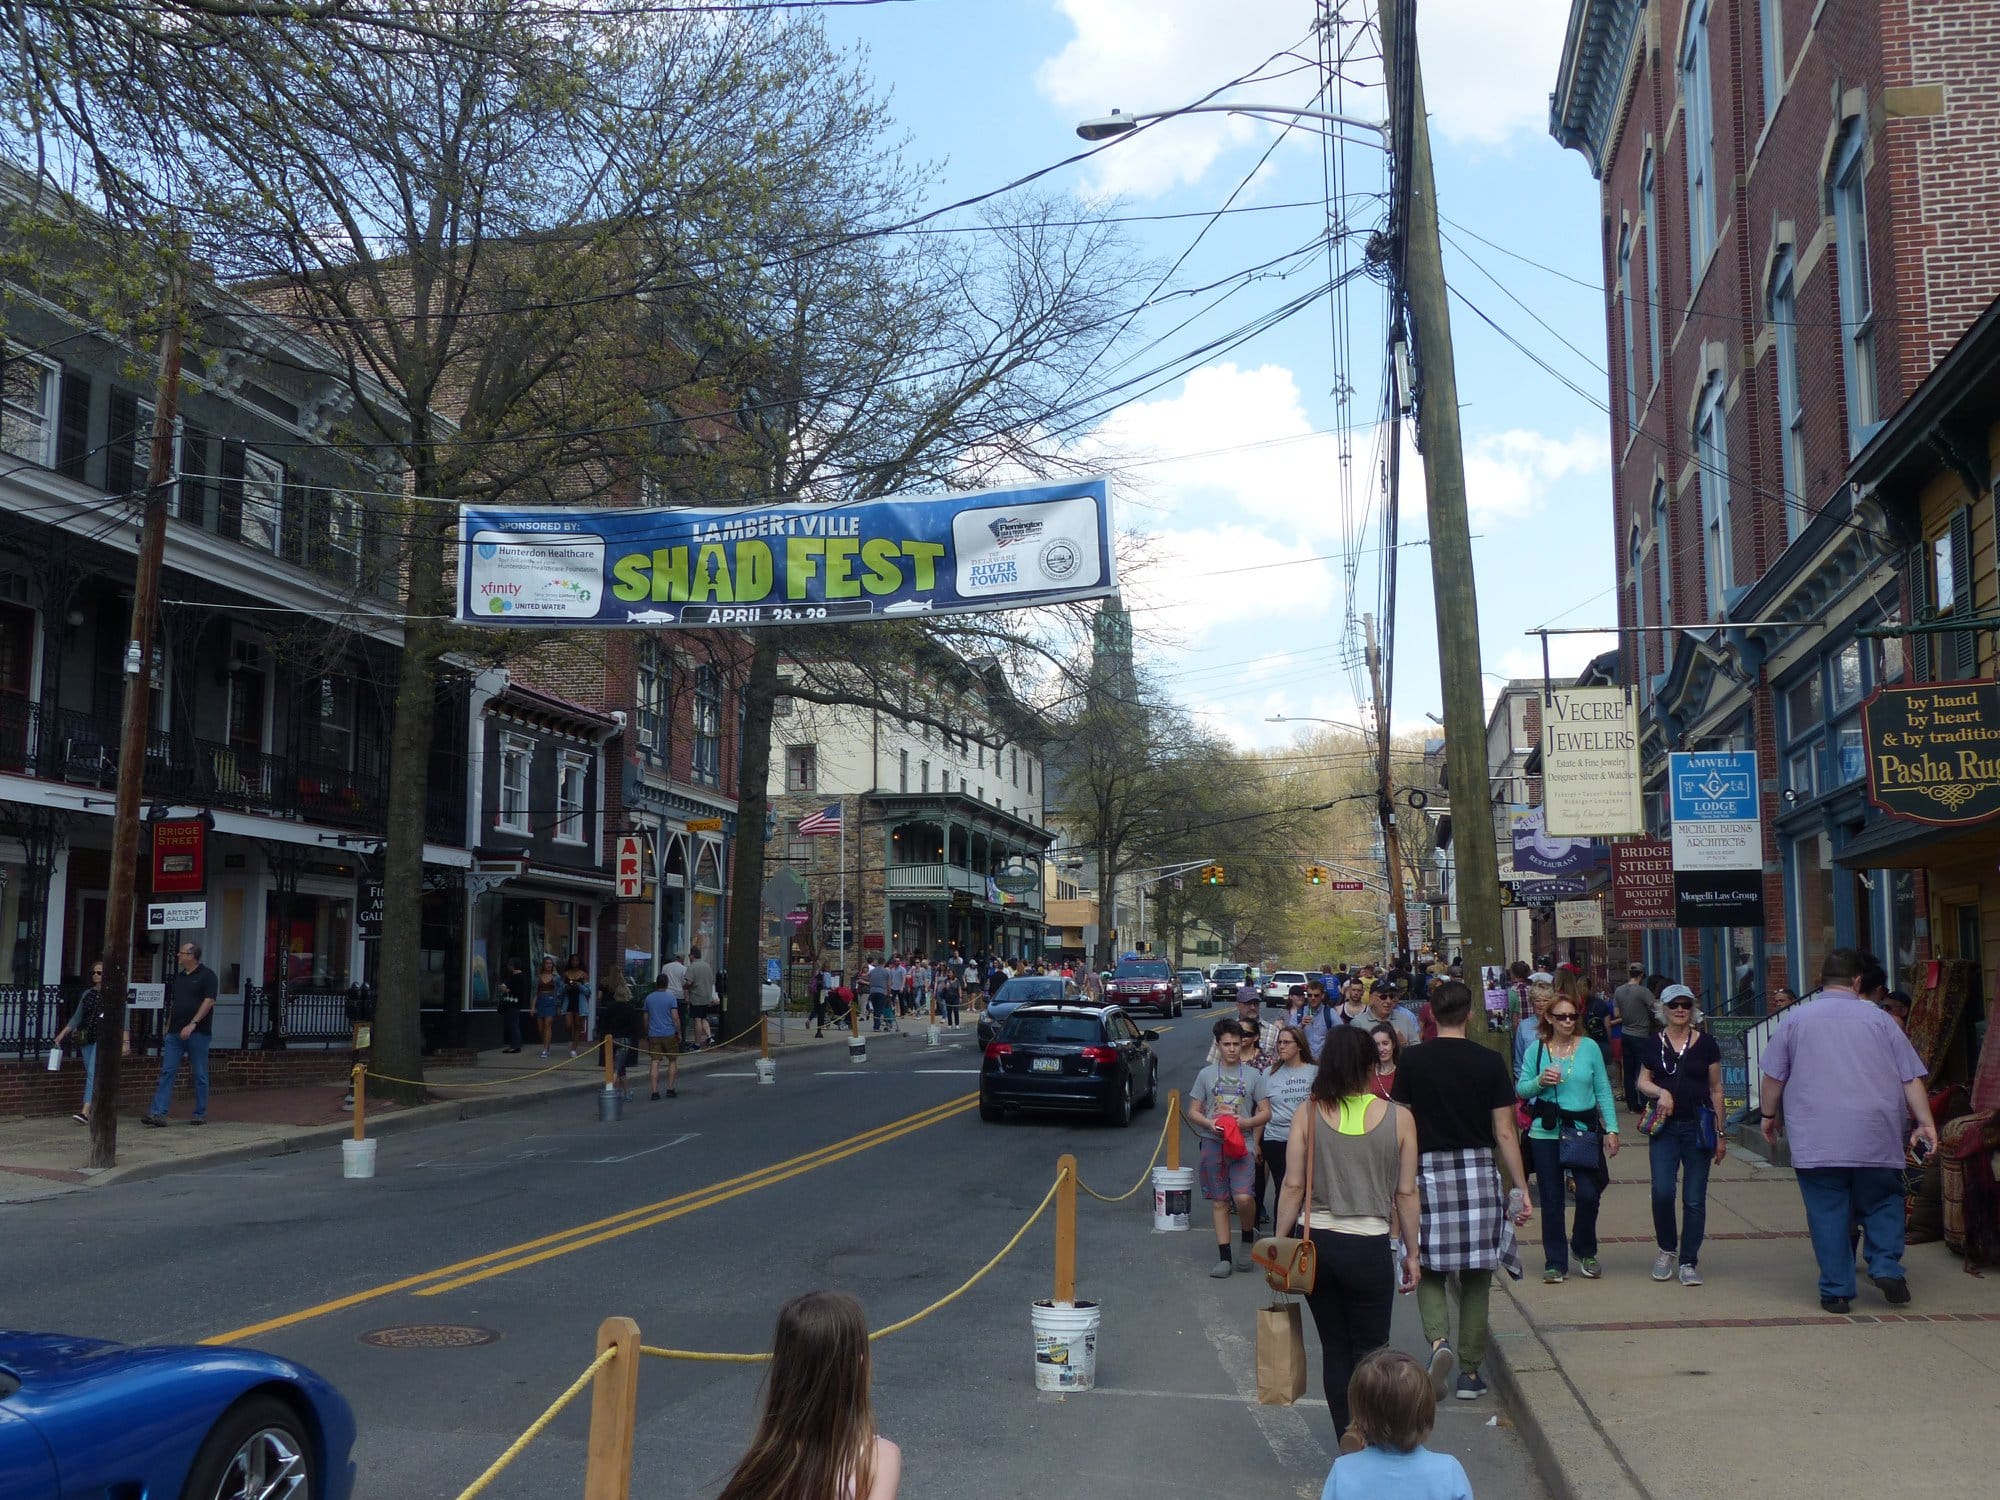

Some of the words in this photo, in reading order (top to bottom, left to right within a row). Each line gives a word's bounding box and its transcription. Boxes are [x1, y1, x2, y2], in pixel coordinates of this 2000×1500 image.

[499, 522, 561, 531] SPONSORED
[563, 522, 581, 531] BY:
[692, 514, 860, 543] LAMBERTVILLE
[999, 520, 1043, 531] Flemington
[499, 547, 546, 557] Hunterdon
[548, 548, 595, 558] Healthcare
[612, 539, 774, 602] SHAD
[786, 537, 945, 600] FEST
[971, 561, 1016, 576] RIVER
[969, 571, 1018, 586] TOWNS
[480, 581, 522, 596] xfinity
[1905, 696, 1929, 712] by
[1932, 692, 1979, 708] hand
[1905, 713, 1929, 729] by
[1932, 709, 1983, 725] heart
[1882, 732, 1900, 747] &
[1901, 731, 1925, 748] by
[1929, 727, 2000, 743] traditio
[1585, 758, 1599, 768] Fine
[1600, 758, 1626, 769] Jewelry
[1686, 757, 1741, 769] AMWELL
[1878, 752, 1954, 785] Pasha
[1708, 780, 1719, 792] G
[1694, 801, 1737, 811] LODGE
[158, 826, 200, 836] BRIDGE
[1678, 824, 1718, 834] MICHAEL
[1720, 823, 1753, 833] BURNS
[158, 836, 200, 846] STREET
[1686, 837, 1746, 848] ARCHITECTS
[1620, 846, 1671, 858] BRIDGE
[620, 838, 639, 896] ART
[1528, 854, 1579, 868] RESTAURANT
[1619, 860, 1673, 872] STREET
[1625, 889, 1670, 898] BOUGHT
[1680, 891, 1713, 903] Mongelli
[1714, 891, 1730, 900] Law
[1732, 890, 1758, 902] Group
[1633, 898, 1662, 907] SOLD
[151, 912, 162, 920] AG
[1621, 908, 1676, 917] APPRAISALS
[165, 915, 201, 923] GALLERY
[280, 980, 288, 1036] STUDIO
